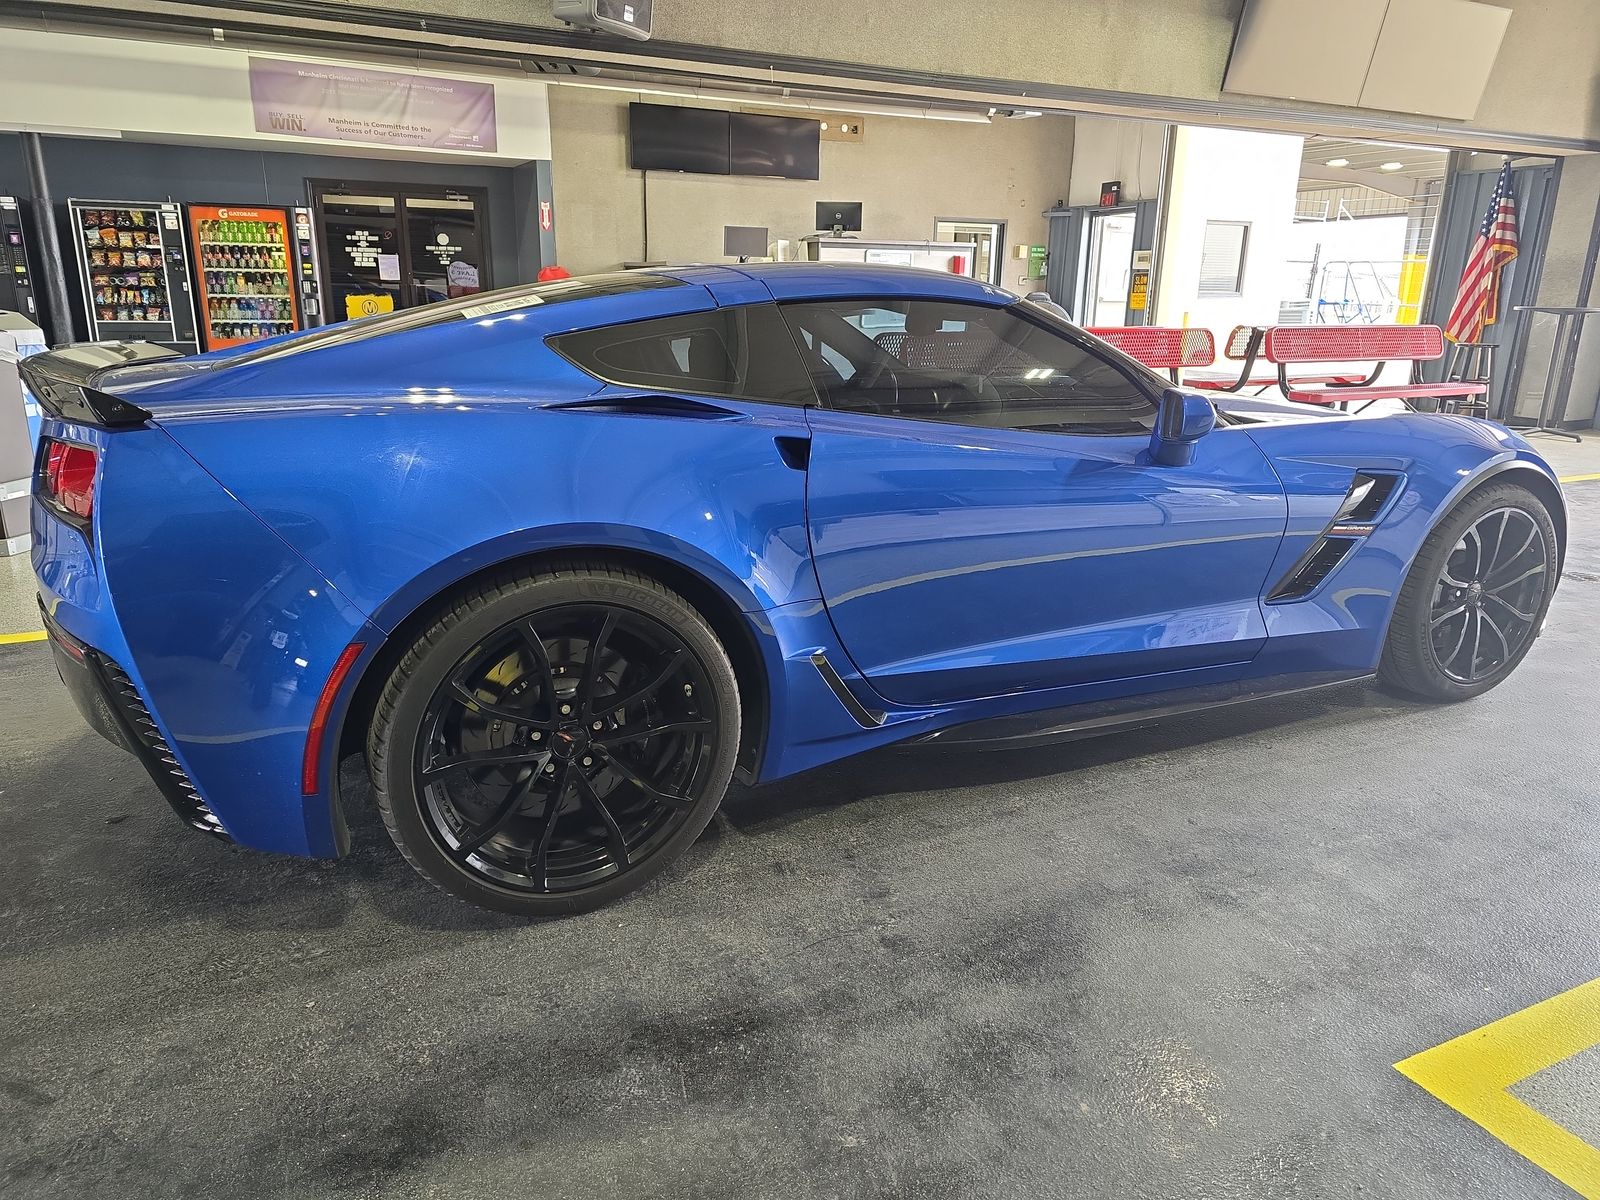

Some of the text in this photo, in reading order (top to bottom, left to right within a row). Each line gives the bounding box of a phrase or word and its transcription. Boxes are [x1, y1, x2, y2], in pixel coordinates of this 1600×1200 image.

[298, 70, 328, 79] Manheim
[328, 74, 359, 83] Cincinnati
[270, 118, 307, 132] WIN.
[328, 118, 362, 127] Manheim
[371, 122, 410, 131] Committed
[335, 126, 363, 134] Success
[388, 131, 426, 140] Customers.
